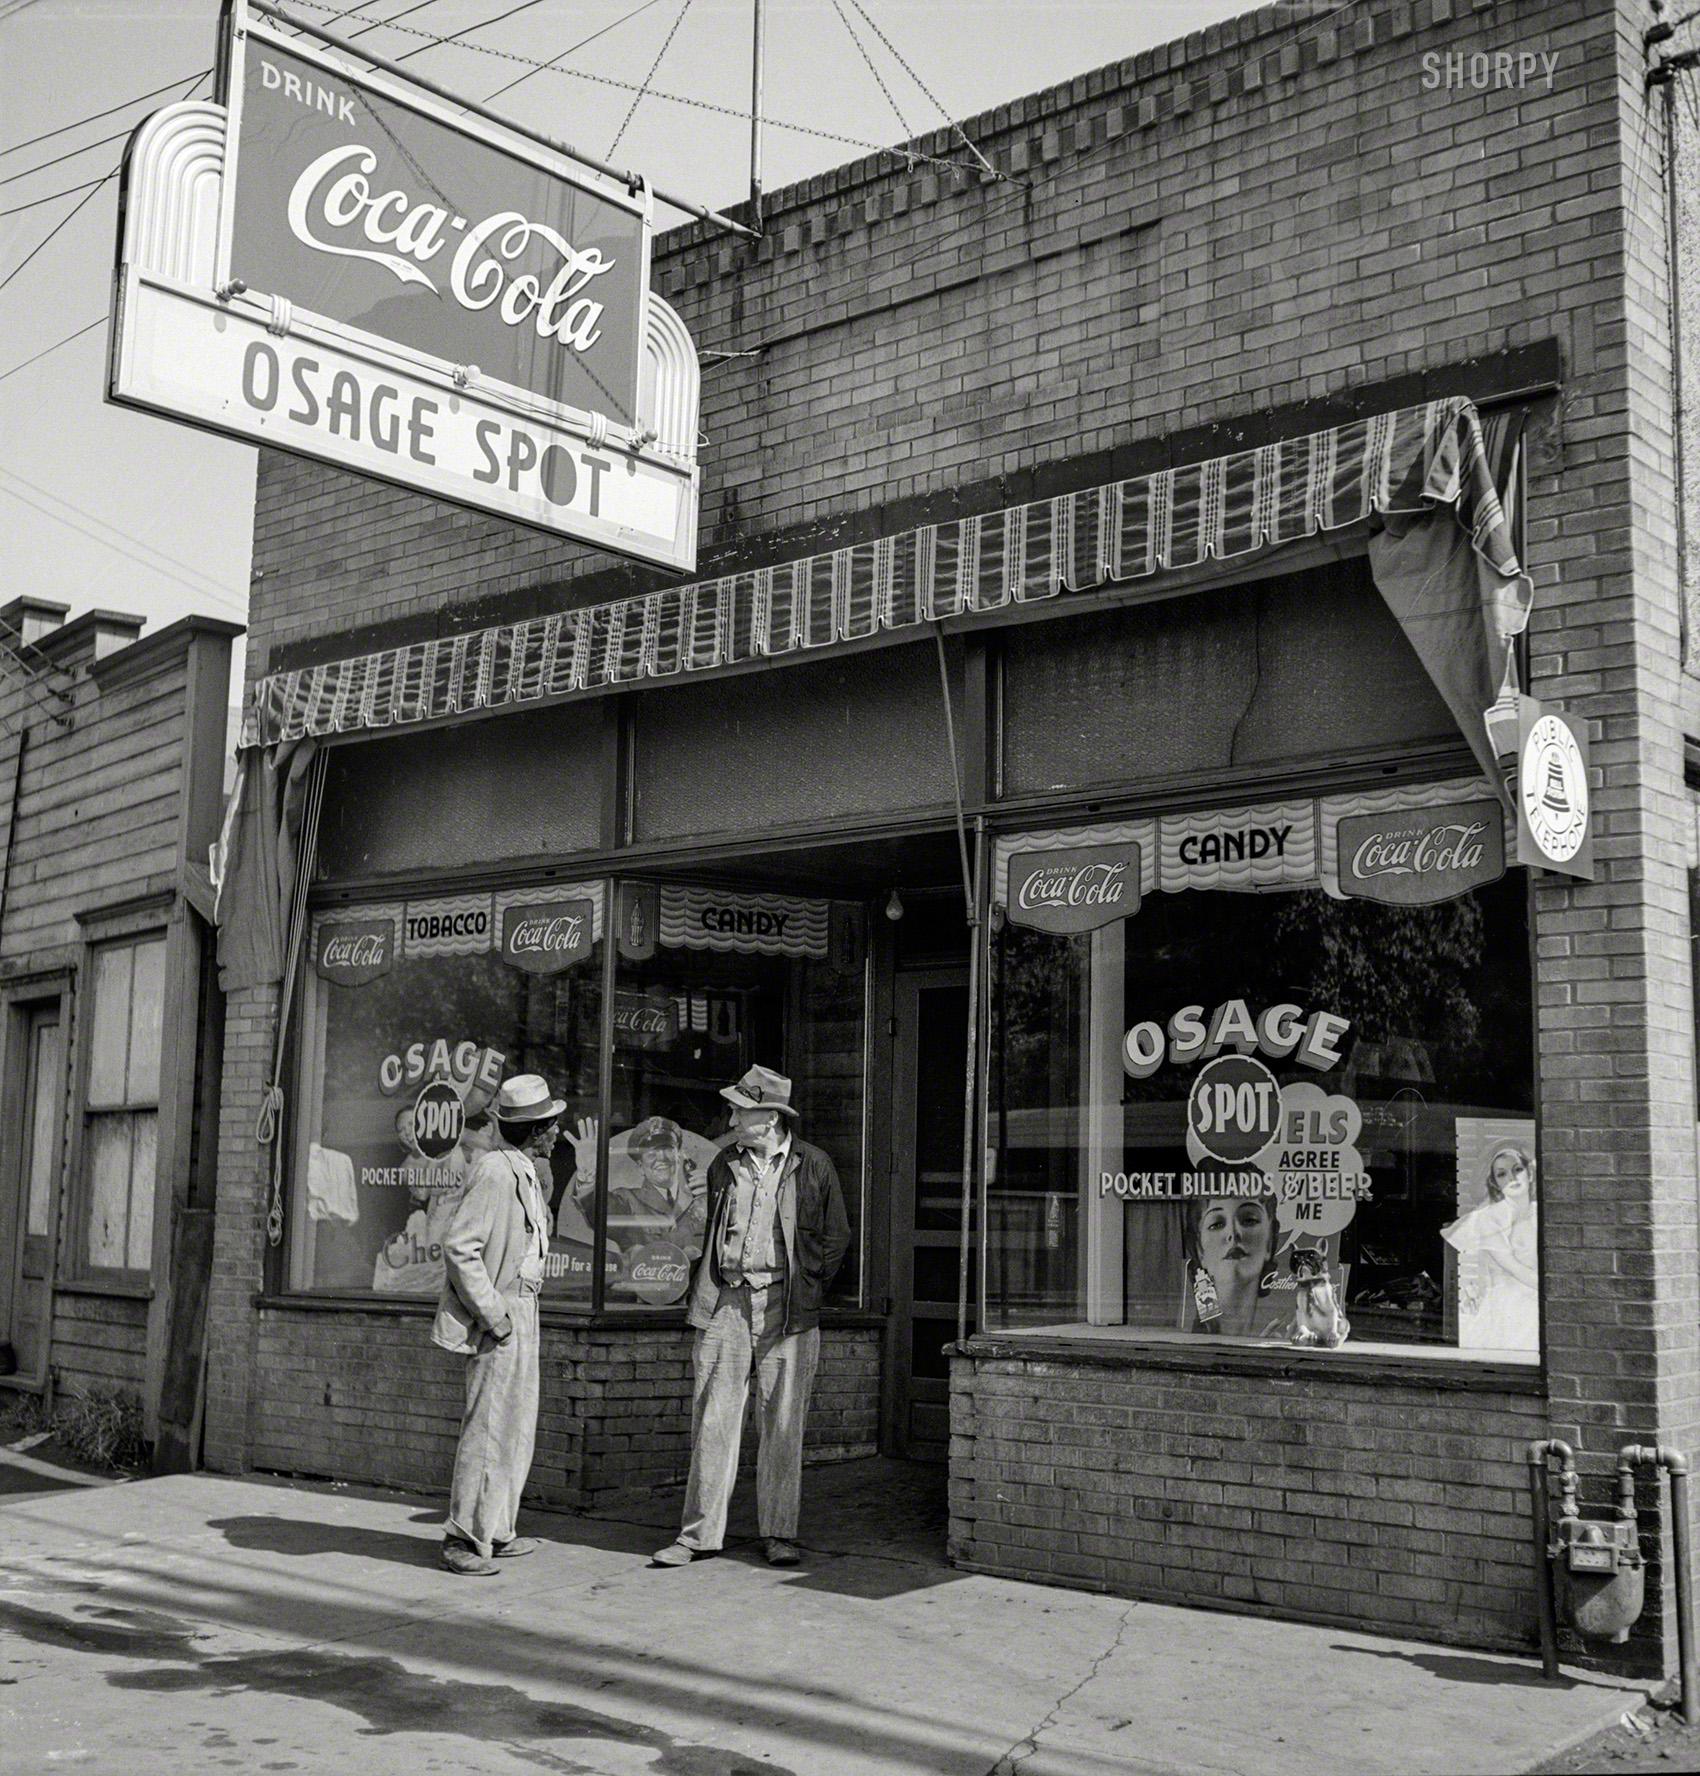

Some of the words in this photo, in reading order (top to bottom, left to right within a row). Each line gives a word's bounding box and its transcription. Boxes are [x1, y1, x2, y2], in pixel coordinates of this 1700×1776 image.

[260, 61, 357, 127] DRINK
[288, 145, 616, 352] Coca-Cola
[242, 340, 439, 467] OSAGE
[473, 419, 610, 518] SPOT
[1532, 719, 1575, 763] PUBLIC
[1386, 829, 1424, 839] DRINK
[1526, 792, 1586, 857] TELEPHONE
[1178, 825, 1292, 866] CANDY
[1352, 822, 1490, 880] Coca-Cola
[1019, 862, 1129, 909] Coca-Cola
[1046, 867, 1077, 875] DRINK
[408, 912, 487, 940] TOBACCO
[510, 915, 585, 954] Coca-Cola
[701, 907, 789, 936] CANDY
[323, 934, 386, 968] Coca-Cola
[1122, 999, 1350, 1078] OSAGE
[379, 1038, 506, 1098] OSAGE
[416, 1100, 461, 1139] SPOT
[1196, 1082, 1273, 1133] SPOT
[362, 1167, 403, 1186] POCKET
[406, 1167, 465, 1189] BILLIARDS
[1279, 1151, 1340, 1168] AGREE
[1100, 1172, 1176, 1198] POCKET
[1181, 1172, 1275, 1197] BILLIARDS
[1280, 1172, 1300, 1204] &
[1306, 1172, 1374, 1201] BEER
[1296, 1203, 1322, 1220] ME
[571, 1257, 585, 1272] for
[586, 1262, 592, 1272] a
[632, 1262, 688, 1282] Coca-Cola
